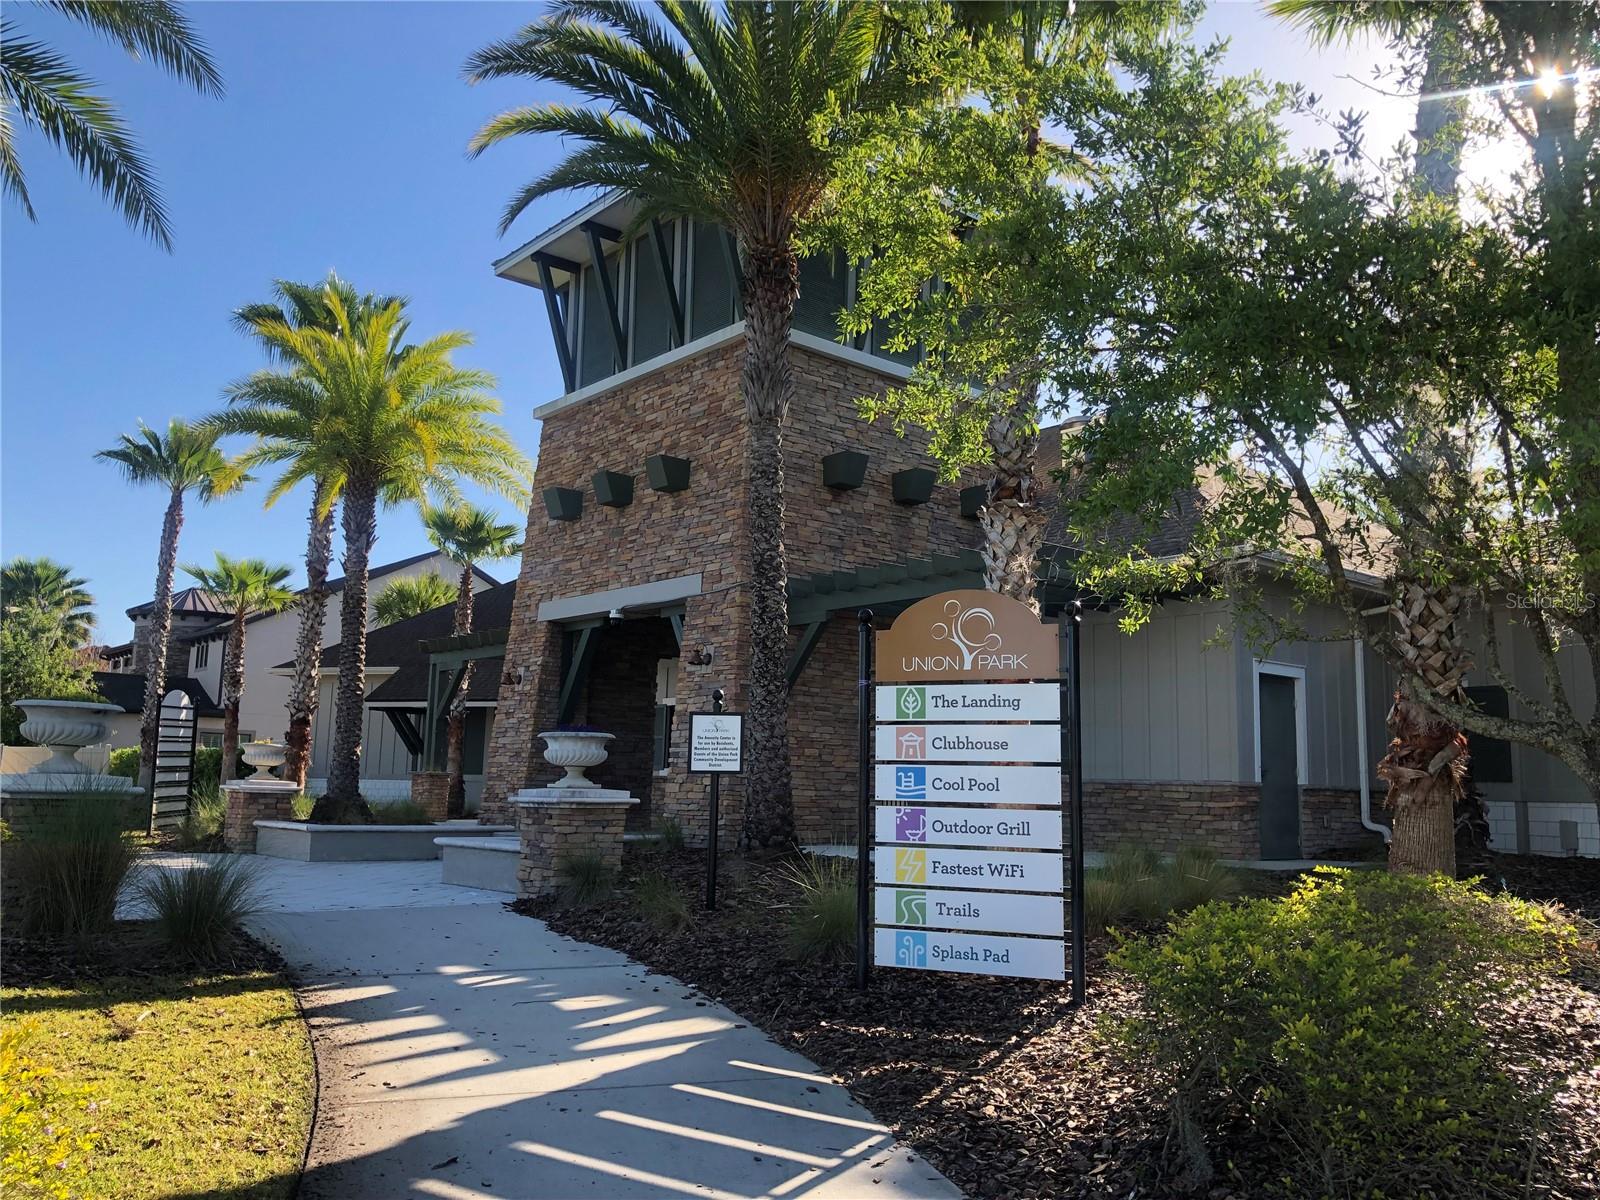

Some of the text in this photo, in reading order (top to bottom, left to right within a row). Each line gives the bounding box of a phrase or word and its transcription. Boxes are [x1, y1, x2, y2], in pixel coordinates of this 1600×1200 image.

[902, 653, 1029, 672] UNION PARK
[931, 693, 1021, 711] The Landing
[931, 736, 1009, 751] Clubhouse
[931, 777, 1000, 792] Cool Pool
[931, 820, 1031, 836] Outdoor Grill
[931, 861, 1025, 878] Fastest WiFi
[935, 902, 980, 918] Trails
[931, 945, 1010, 963] Splash Pad
